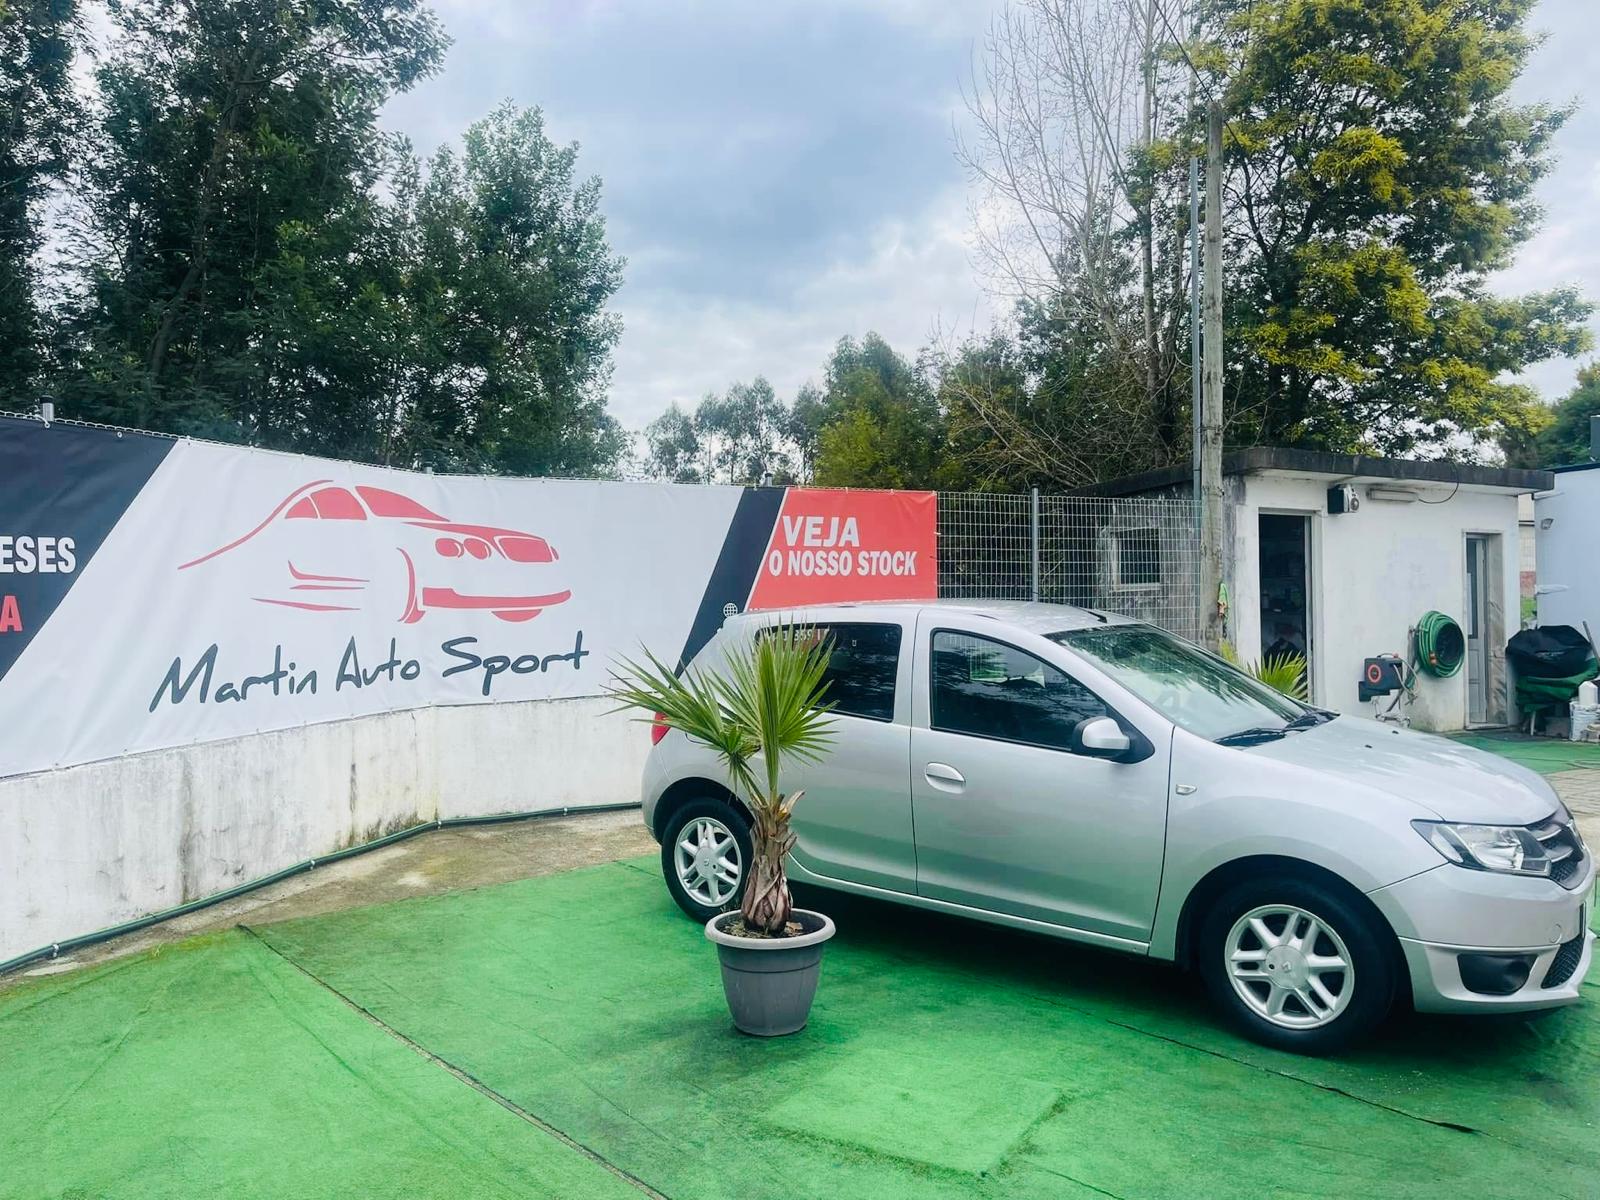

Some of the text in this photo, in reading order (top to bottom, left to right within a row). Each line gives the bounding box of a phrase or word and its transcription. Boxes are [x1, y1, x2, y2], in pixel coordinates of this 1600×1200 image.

[782, 515, 860, 547] VEJA
[0, 536, 76, 574] ESES
[768, 549, 917, 577] O NOSSO STOCK
[0, 595, 23, 632] A
[148, 630, 589, 713] Martin Auto Sport
